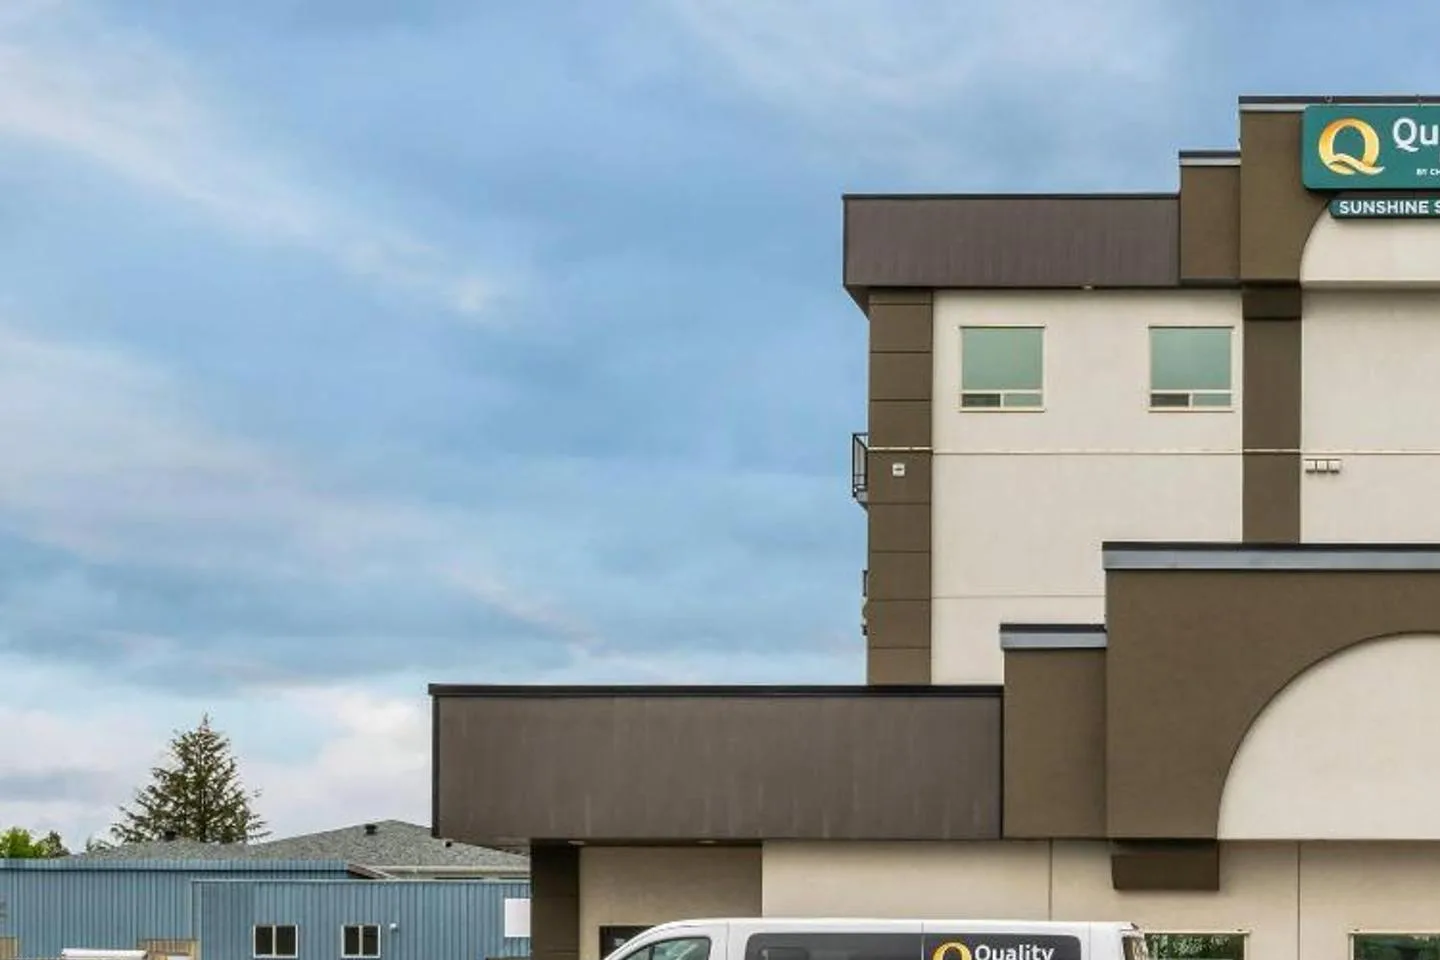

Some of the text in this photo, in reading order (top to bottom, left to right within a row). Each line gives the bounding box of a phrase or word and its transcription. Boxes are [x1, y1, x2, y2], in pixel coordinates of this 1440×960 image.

[1318, 117, 1385, 175] Q
[1416, 168, 1428, 176] BY
[1339, 200, 1429, 214] SUNSHINE
